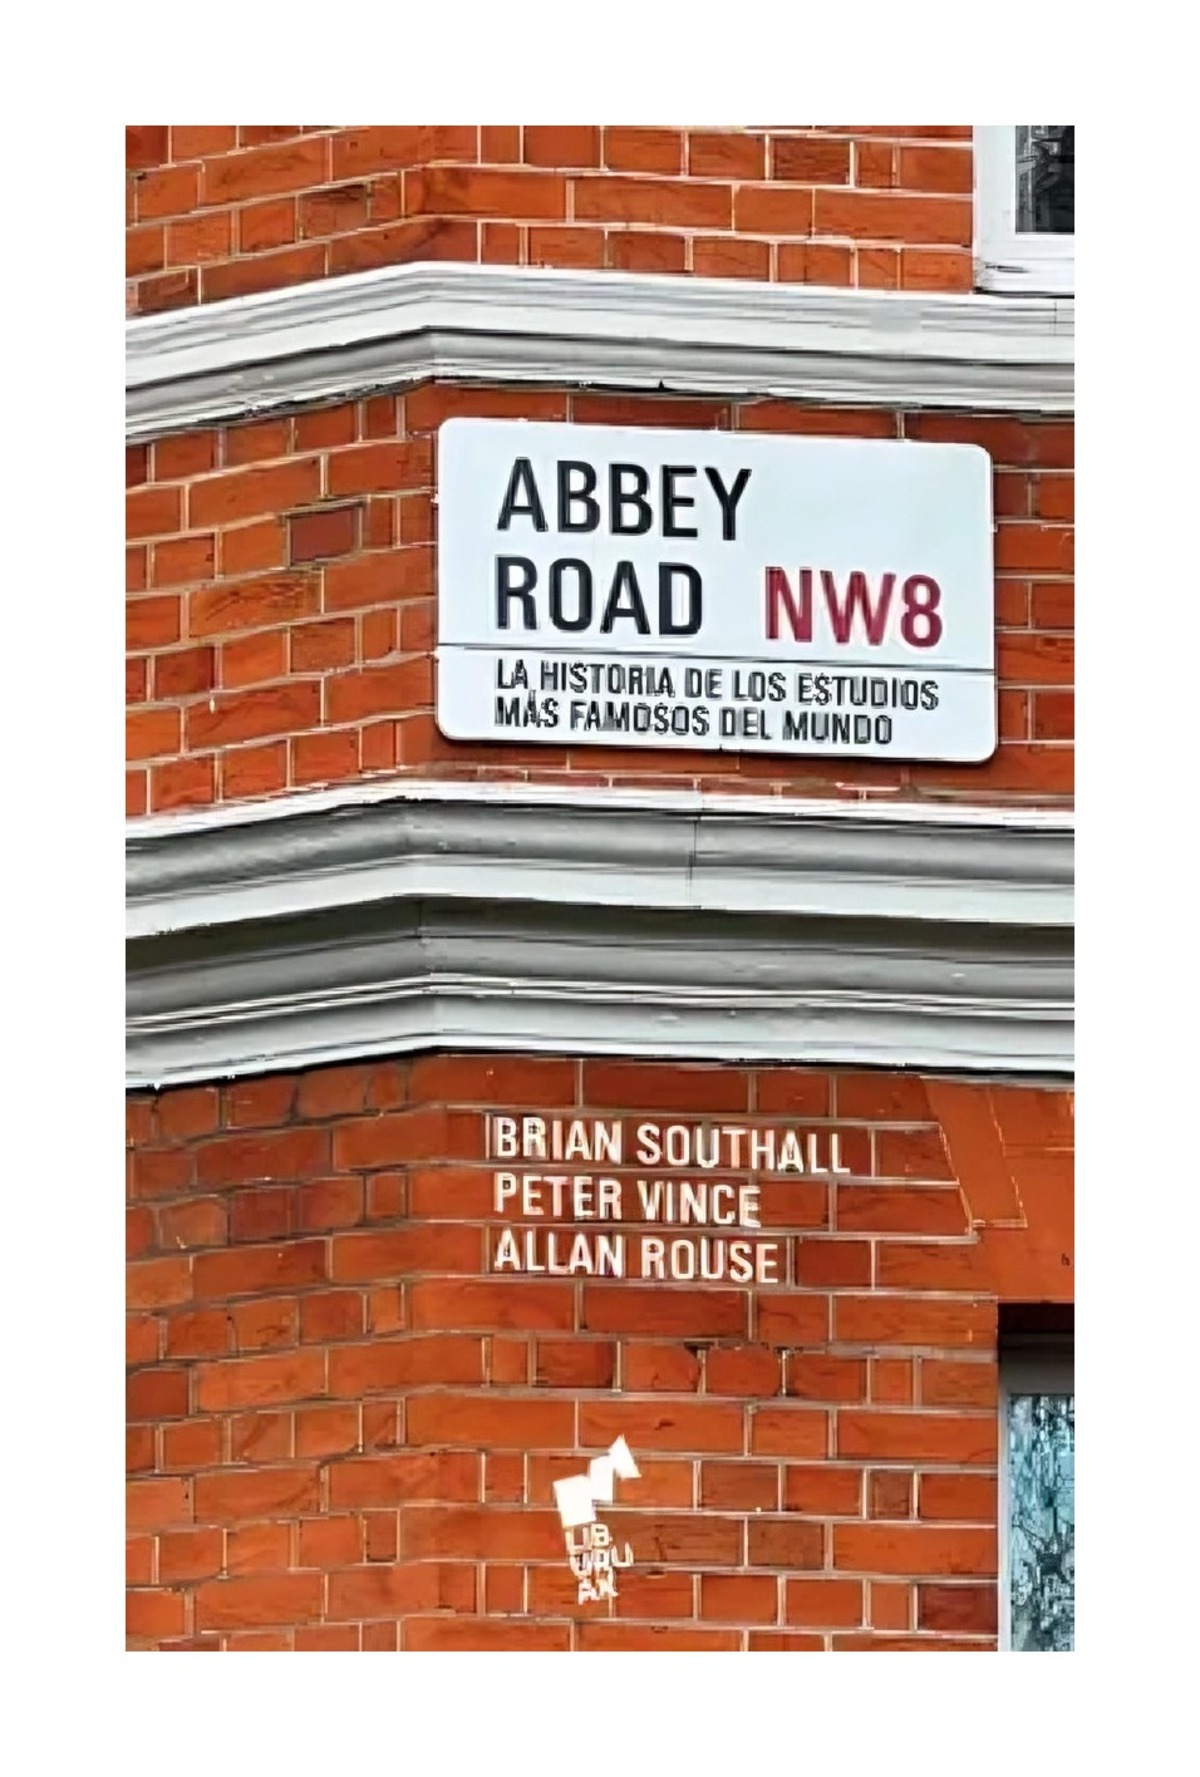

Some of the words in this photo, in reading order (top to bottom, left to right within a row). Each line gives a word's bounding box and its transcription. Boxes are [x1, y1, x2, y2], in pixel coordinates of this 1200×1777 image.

[497, 457, 752, 541] ABBEY
[495, 554, 703, 636] ROAD
[764, 566, 944, 648] NW8
[496, 658, 528, 690] LA
[540, 660, 676, 698] HISTORIA
[684, 667, 722, 699] DE
[734, 669, 787, 703] LOS
[799, 672, 940, 711] ESTUDIOS
[569, 700, 710, 737] FAMOSOS
[719, 706, 772, 740] DEL
[782, 711, 893, 746] MUNDO
